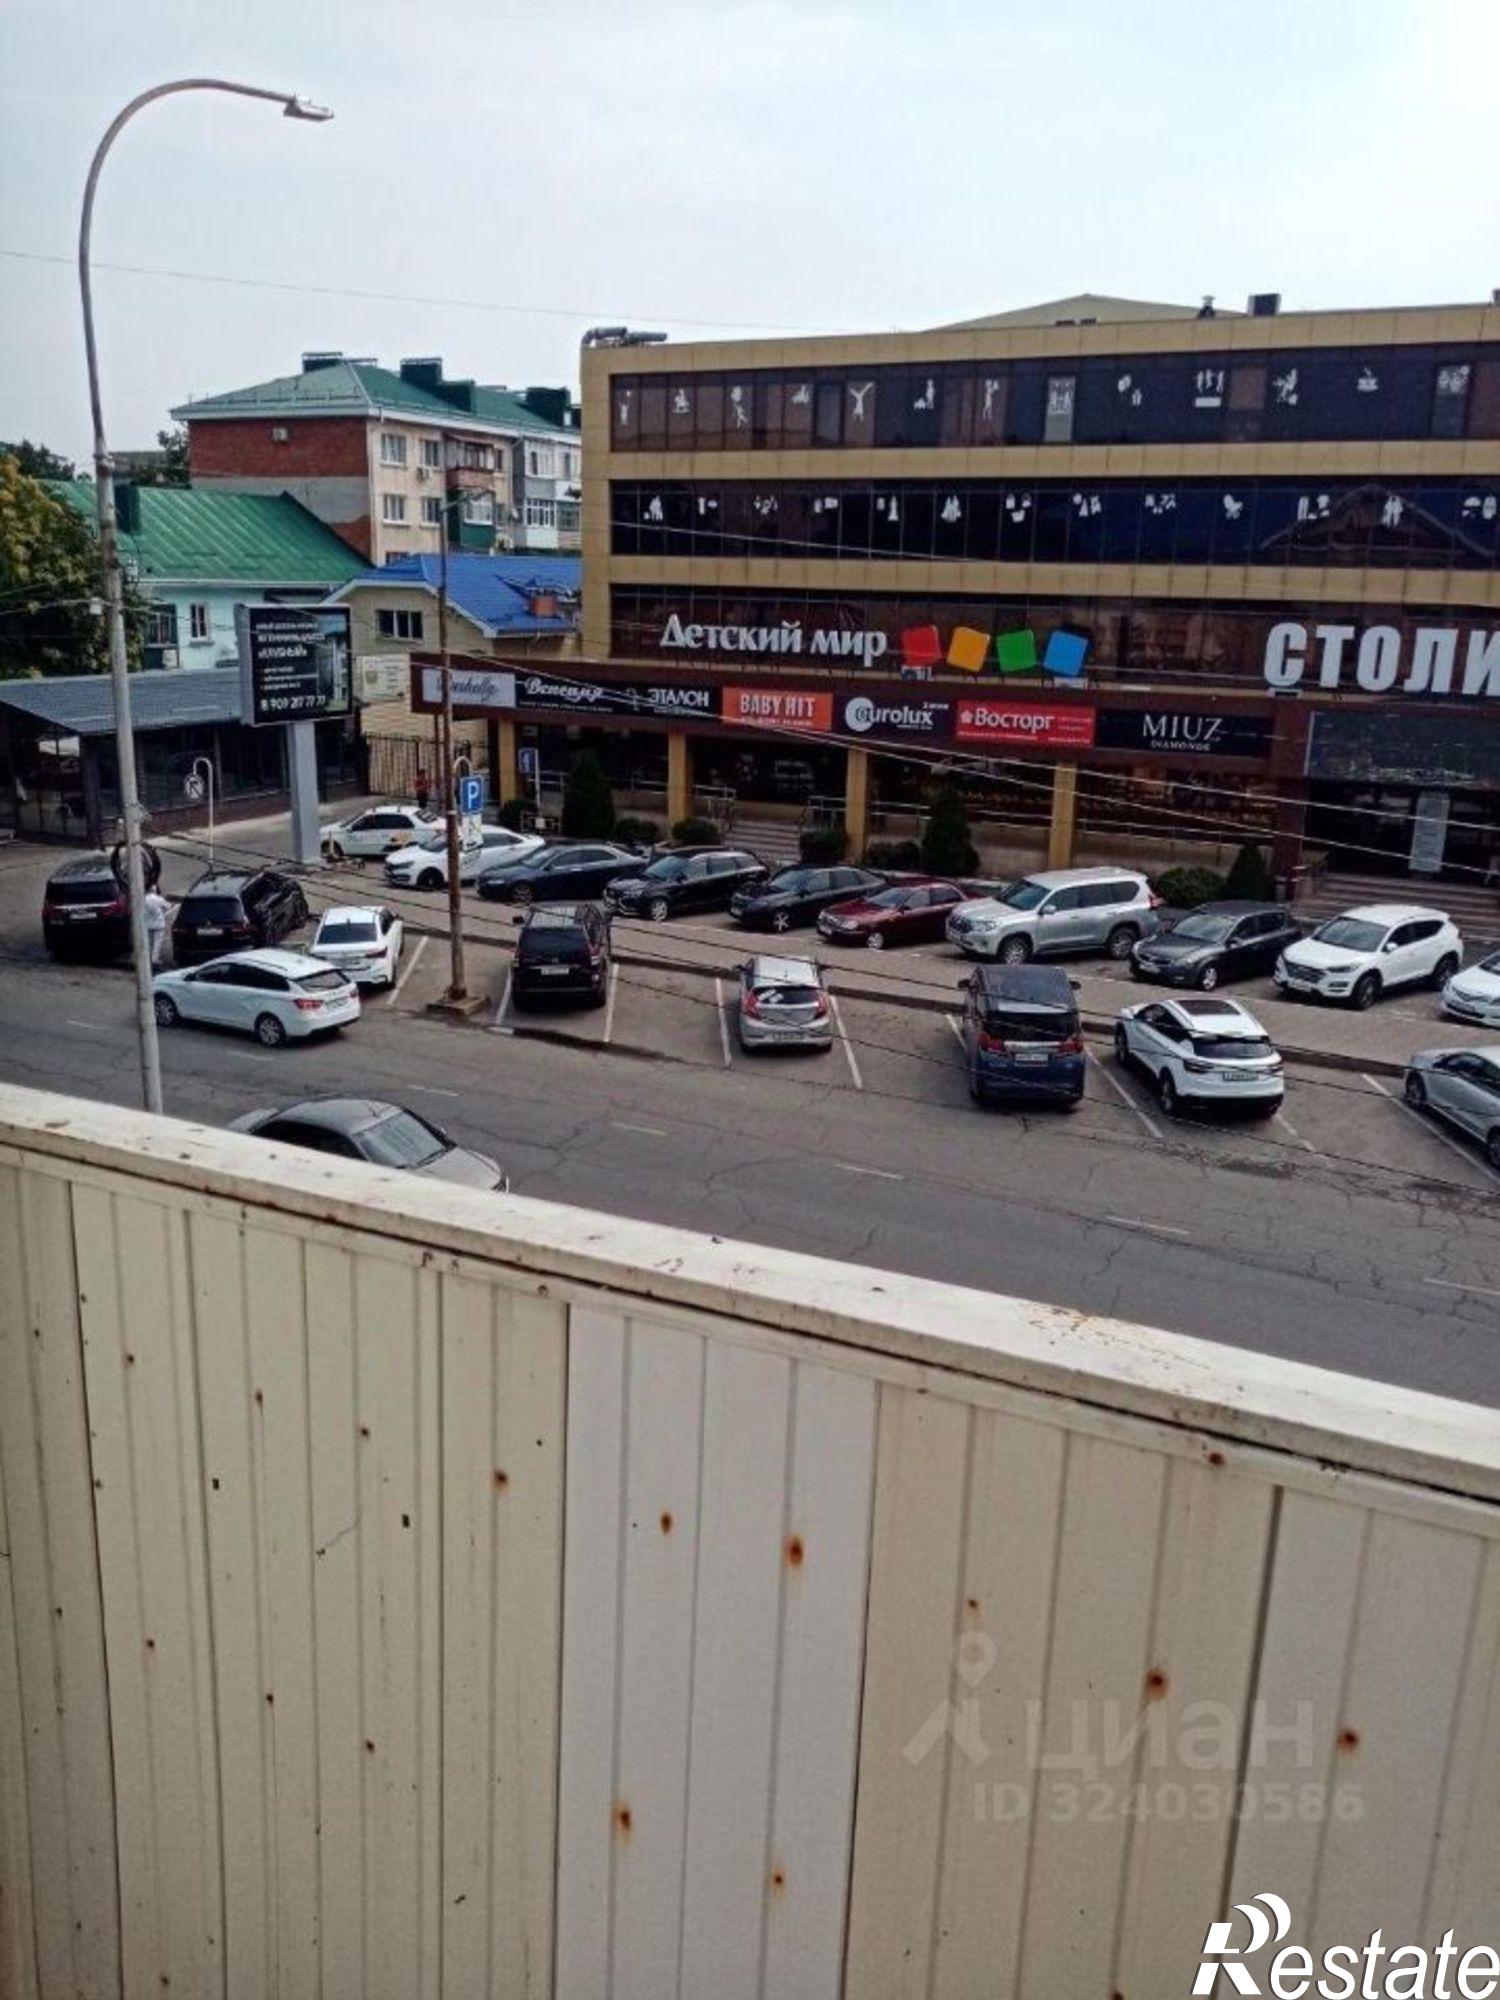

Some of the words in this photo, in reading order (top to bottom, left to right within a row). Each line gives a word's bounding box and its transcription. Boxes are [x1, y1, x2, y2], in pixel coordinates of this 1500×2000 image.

[660, 613, 801, 653] Детский
[810, 629, 887, 667] мир
[1264, 622, 1500, 696] СТОЛИ
[648, 689, 709, 707] ЭТАЛОН
[740, 694, 781, 716] BABY
[785, 697, 815, 717] HIT
[974, 708, 1055, 734] Восторг
[1143, 714, 1223, 741] MIUZ
